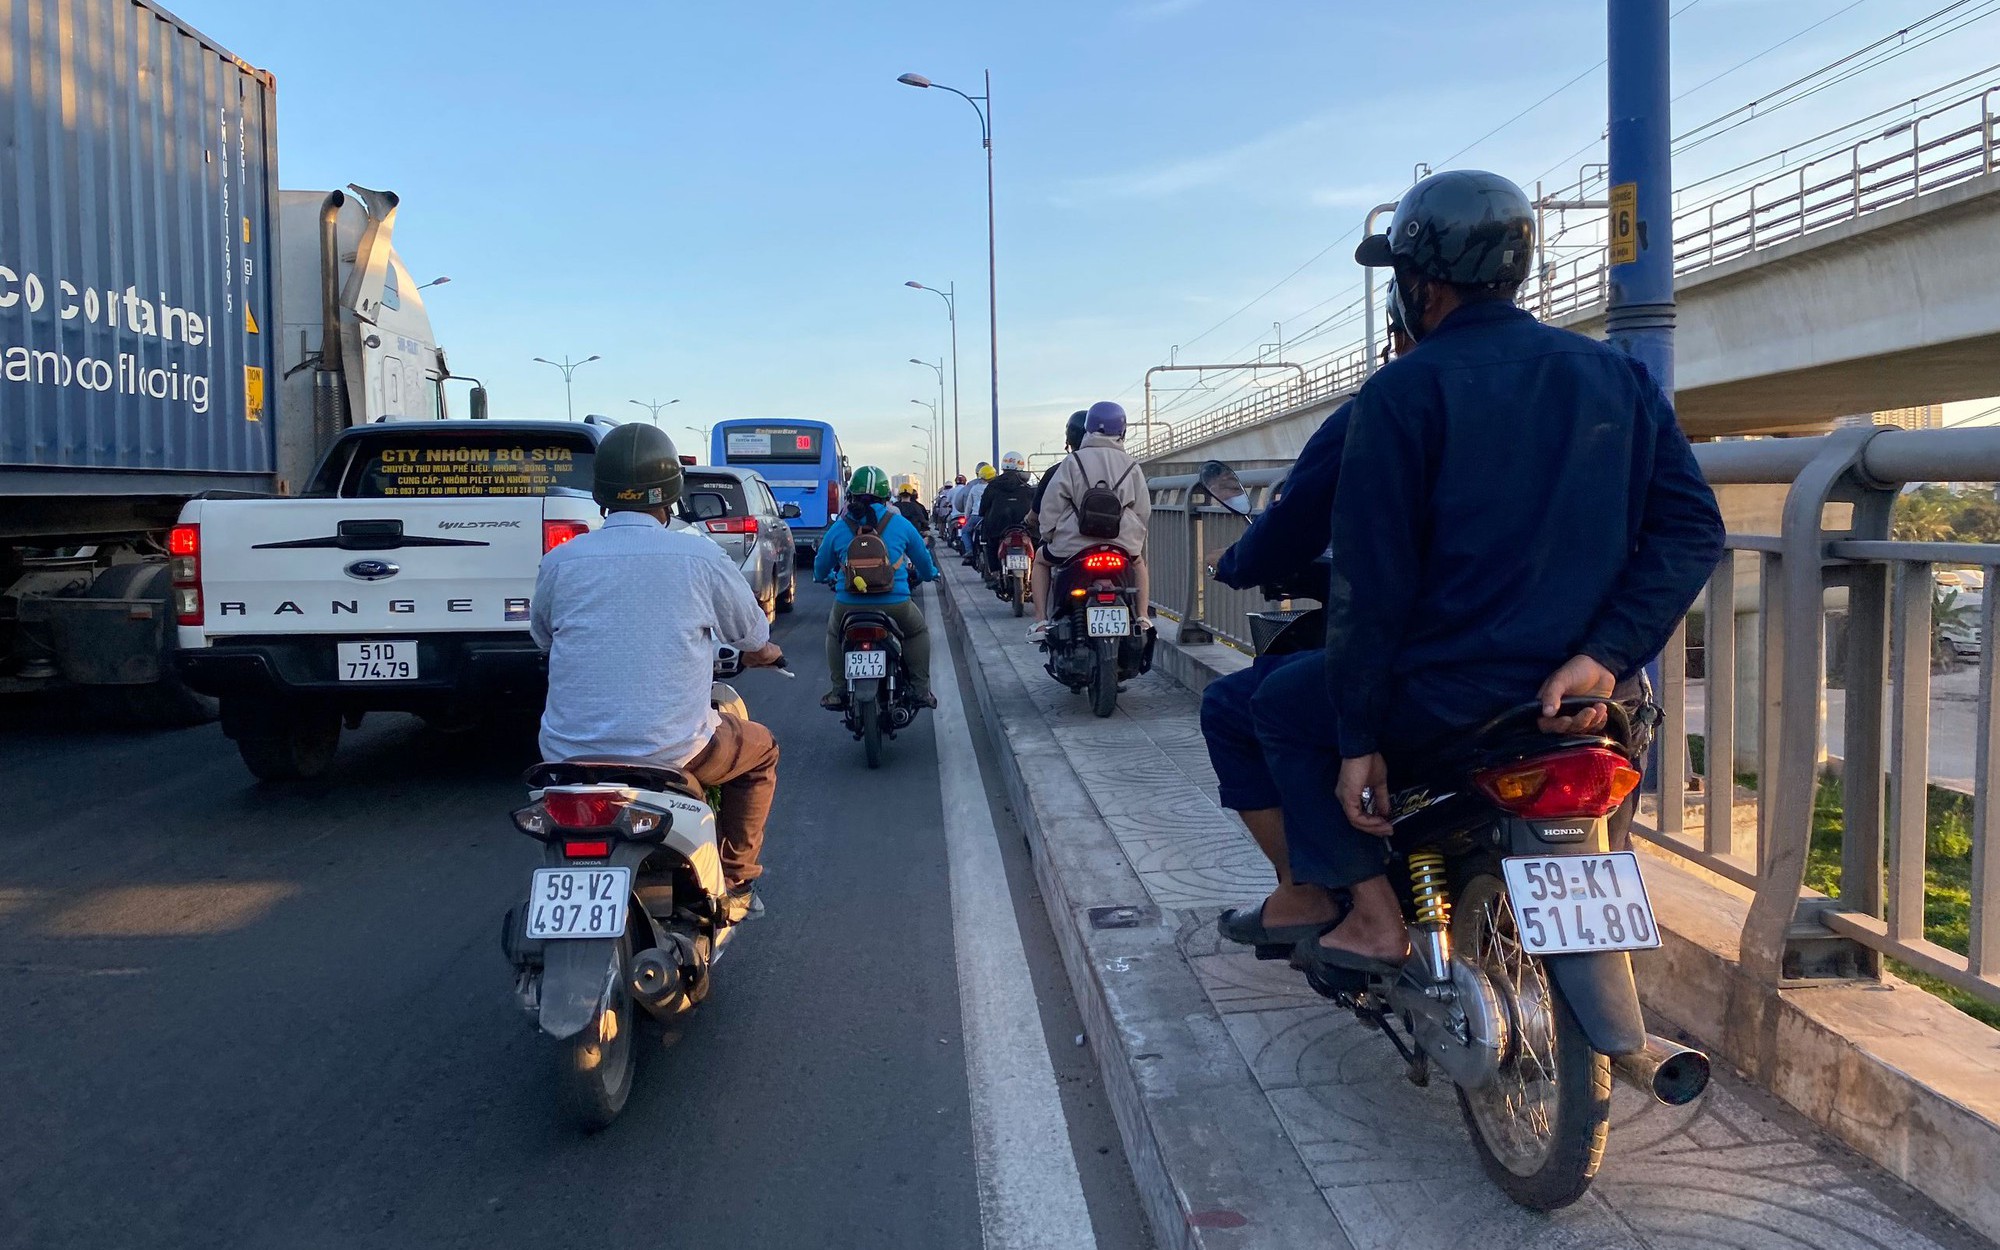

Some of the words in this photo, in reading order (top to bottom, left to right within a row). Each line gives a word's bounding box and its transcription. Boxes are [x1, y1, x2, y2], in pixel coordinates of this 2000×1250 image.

[1611, 210, 1630, 238] 16
[381, 449, 420, 462] CTY
[415, 464, 431, 473] THU
[432, 464, 451, 473] MUA
[397, 476, 420, 485] CUNG
[438, 520, 521, 530] WILDTRAK
[220, 598, 531, 617] RANGER
[1093, 609, 1122, 622] 77-C1
[1090, 622, 1127, 634] 664.57
[360, 643, 395, 660] 51D
[851, 653, 880, 665] 59-L2
[346, 661, 410, 679] 774.79
[848, 664, 883, 677] 444.12
[669, 799, 702, 813] VISION
[1543, 828, 1585, 836] HONDA
[1523, 858, 1623, 901] 59-K1
[546, 873, 615, 901] 59-V2
[534, 903, 618, 933] 497.81
[1522, 902, 1650, 947] 514.80
